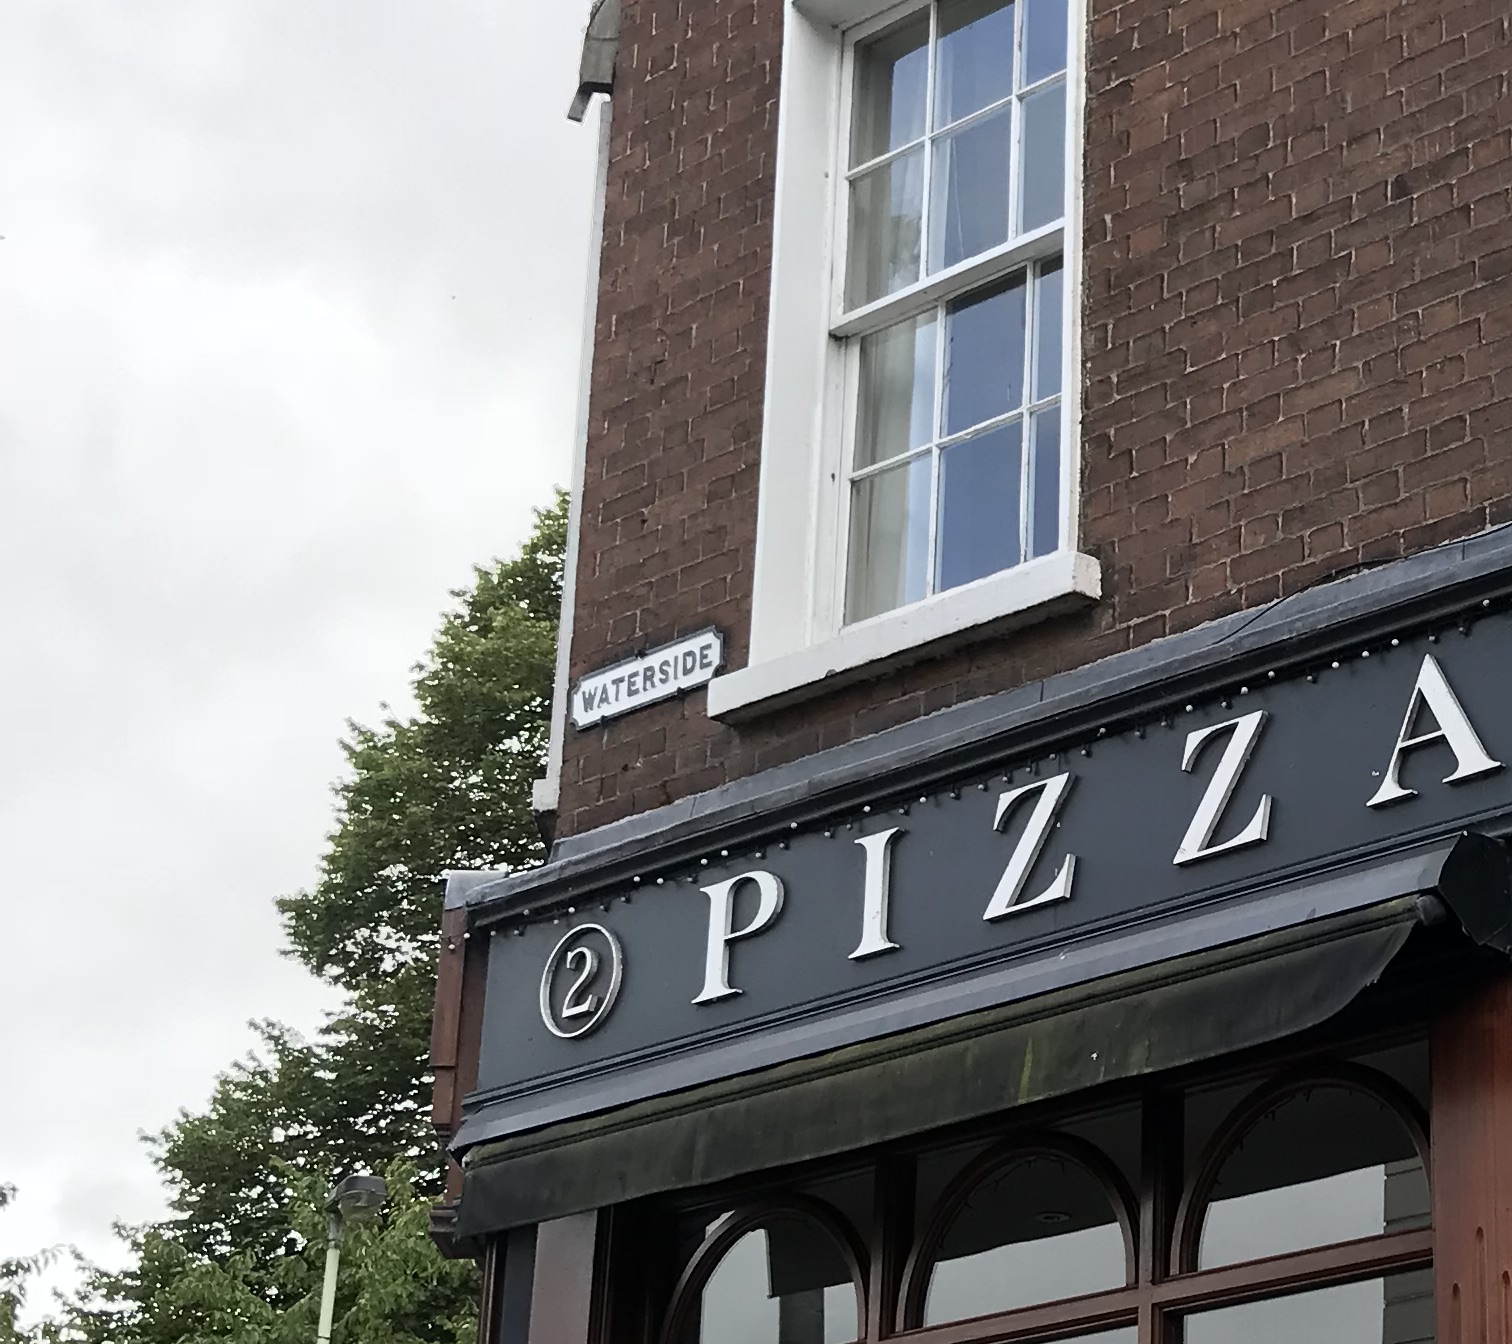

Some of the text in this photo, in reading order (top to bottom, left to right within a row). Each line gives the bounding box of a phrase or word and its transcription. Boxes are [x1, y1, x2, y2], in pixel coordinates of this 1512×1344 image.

[582, 642, 713, 713] WATERSIDE
[561, 946, 599, 1019] 2
[691, 653, 1506, 1005] PIZZA
